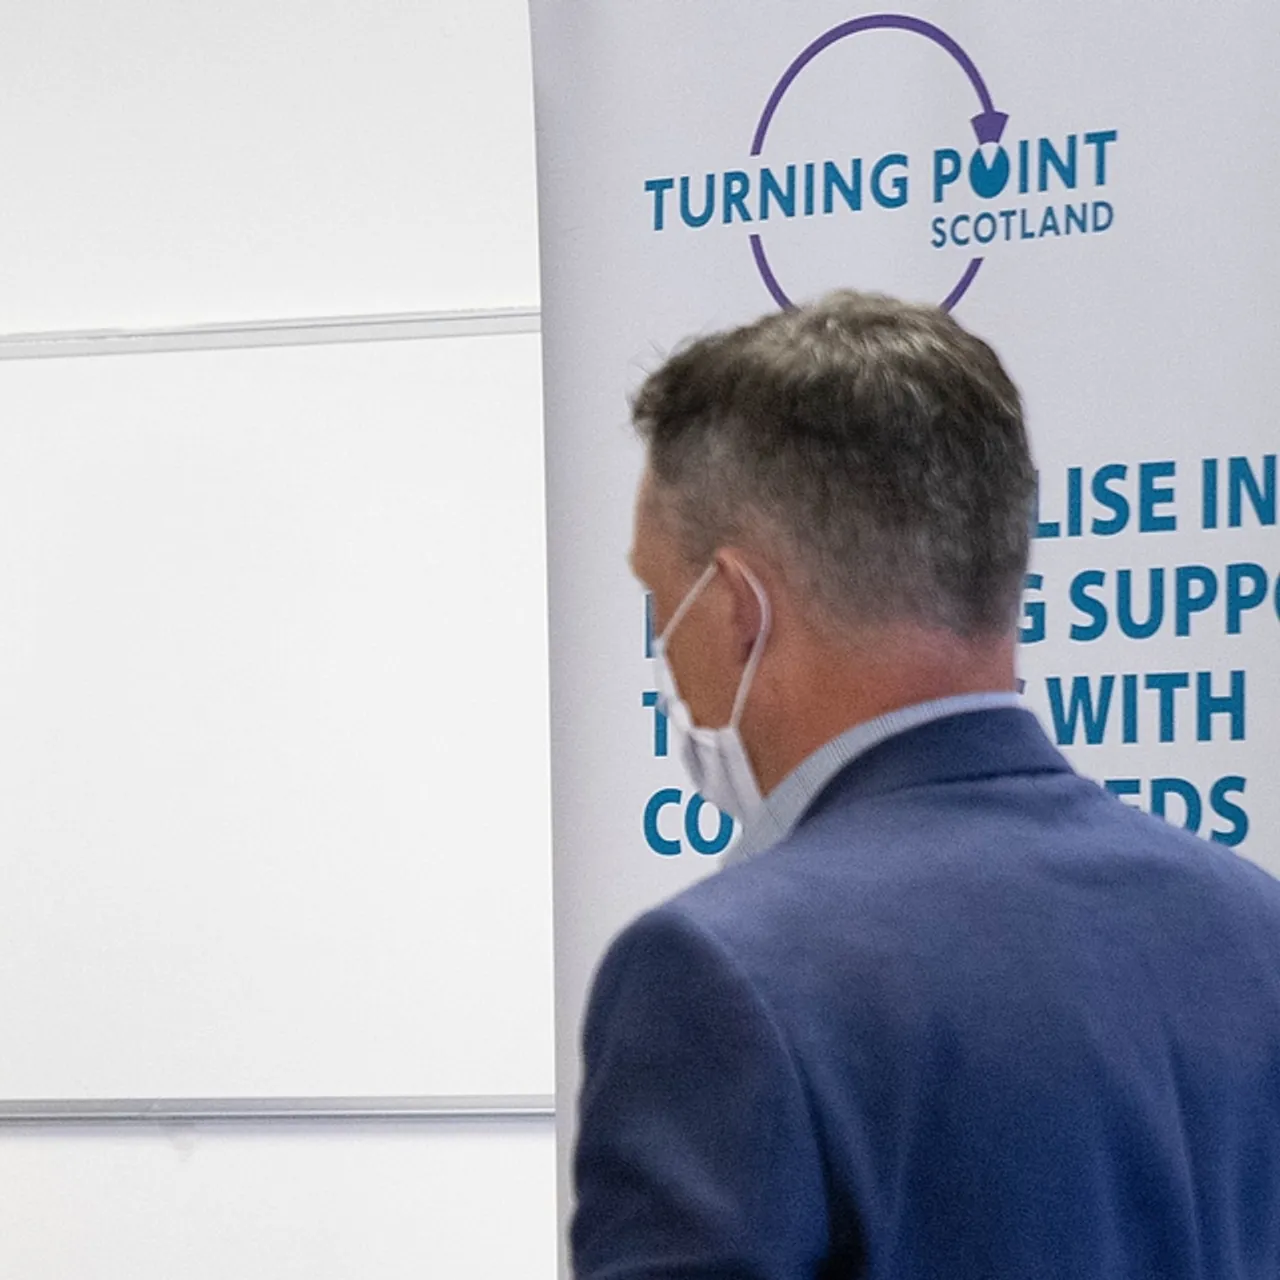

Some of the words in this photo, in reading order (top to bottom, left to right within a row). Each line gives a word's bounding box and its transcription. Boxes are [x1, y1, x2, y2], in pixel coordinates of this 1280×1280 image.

[644, 152, 909, 232] TURNING
[932, 129, 1118, 204] POINT
[930, 200, 1115, 250] SCOTLAND
[1029, 462, 1177, 539] LISE
[1201, 453, 1277, 530] IN
[1068, 562, 1280, 643] SUPP
[1045, 670, 1246, 746] WITH
